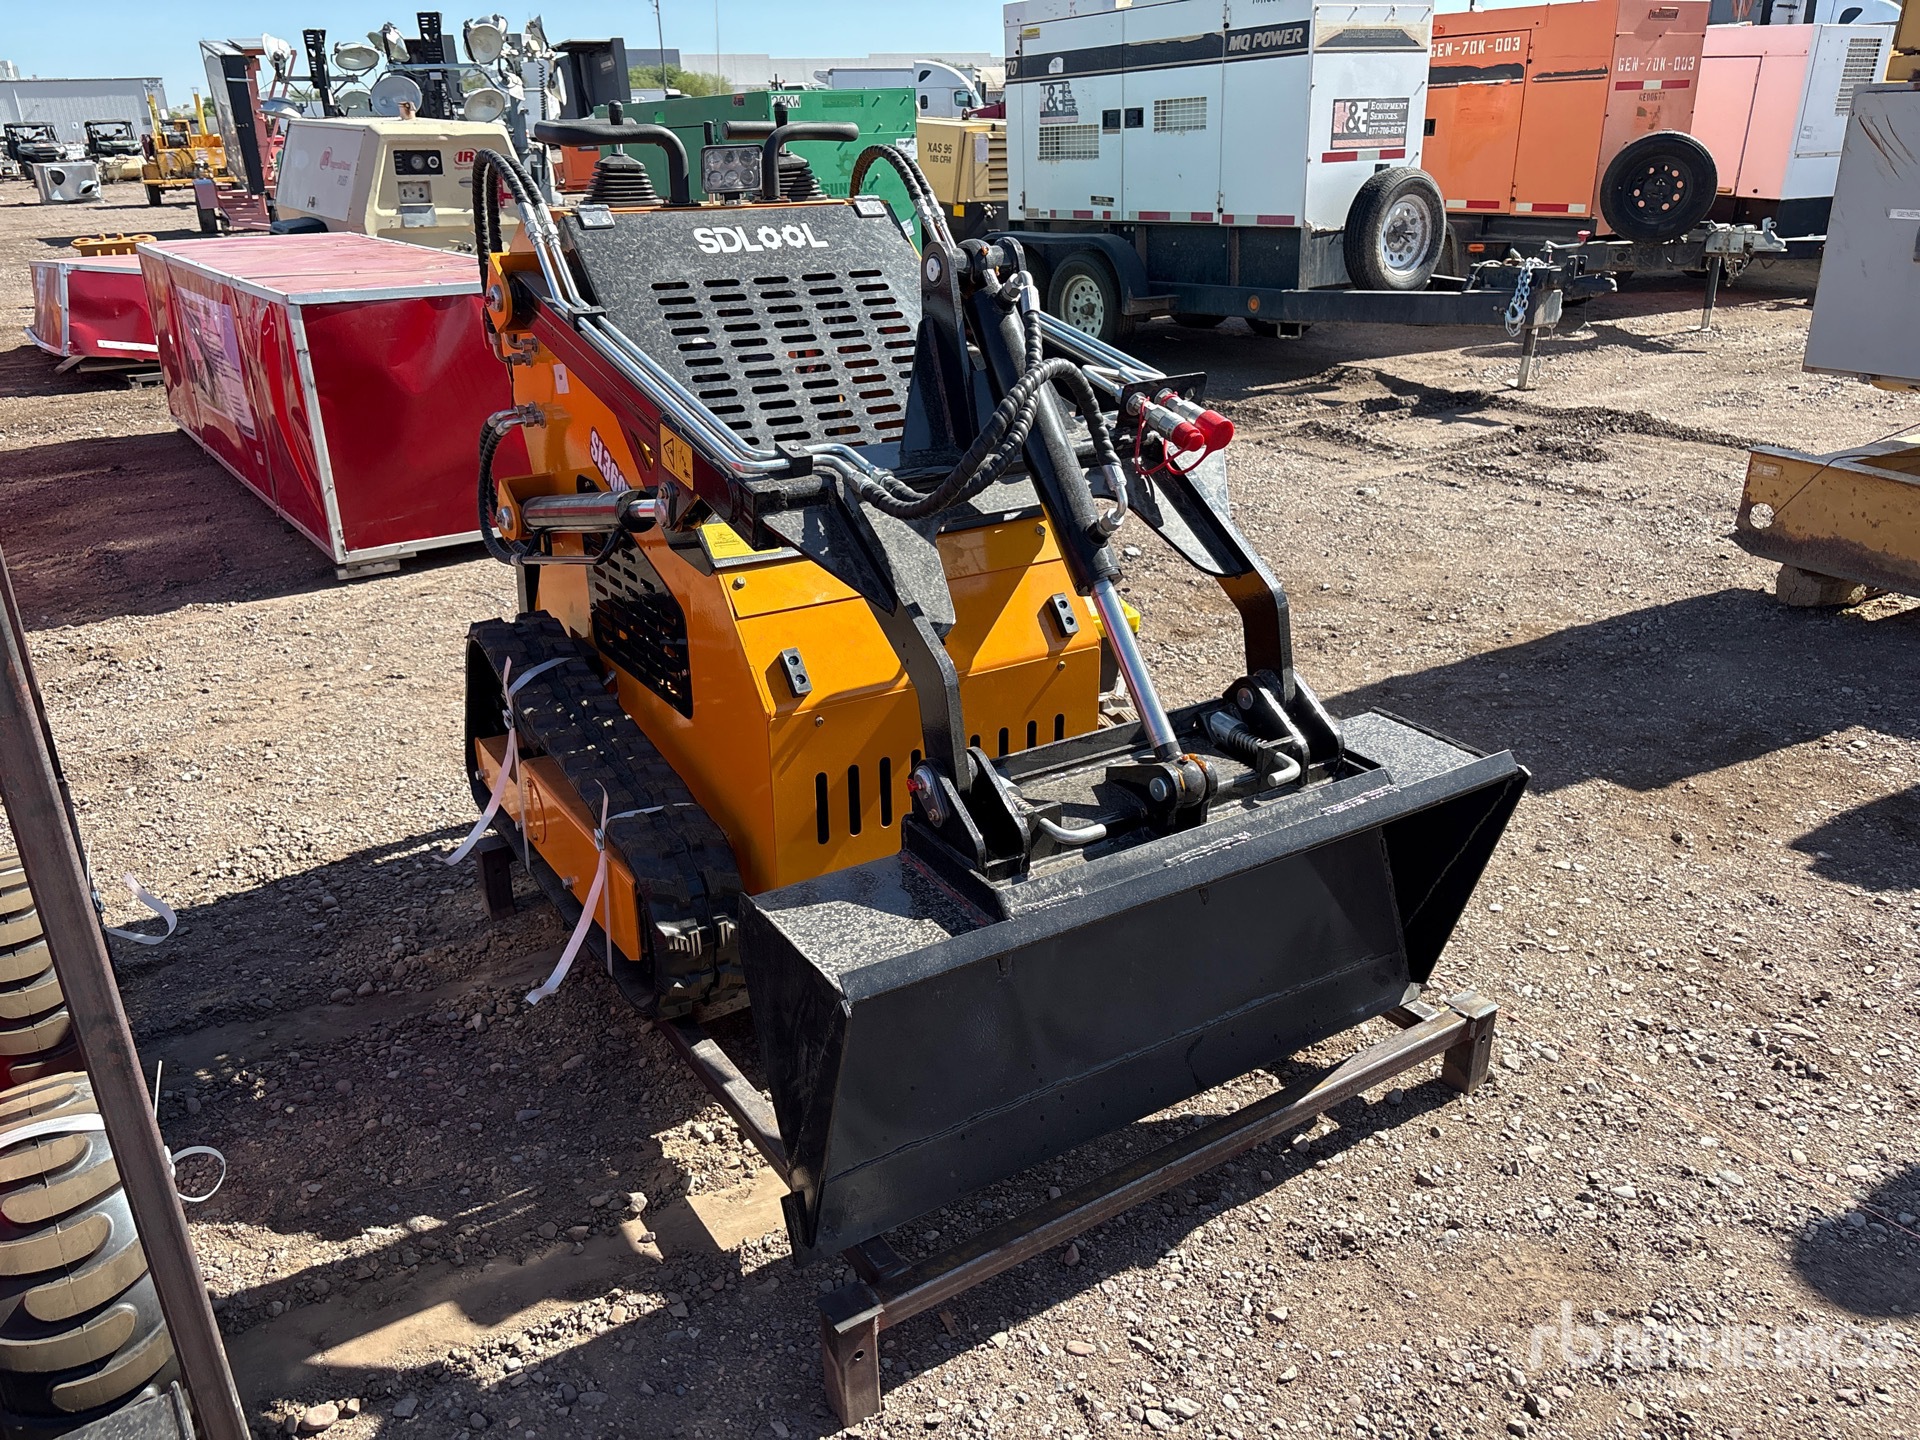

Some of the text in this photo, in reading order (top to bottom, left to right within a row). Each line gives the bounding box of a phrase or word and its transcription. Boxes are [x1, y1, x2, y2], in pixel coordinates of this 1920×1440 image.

[1228, 28, 1303, 52] MQ POWER
[1430, 37, 1520, 58] GEN-70K-003
[1618, 56, 1695, 72] GEN-70K-003
[1371, 101, 1408, 110] EQUIPMENT
[927, 142, 942, 153] XAS
[943, 144, 953, 154] 96
[457, 151, 475, 162] IR
[821, 181, 875, 195] SUNLT
